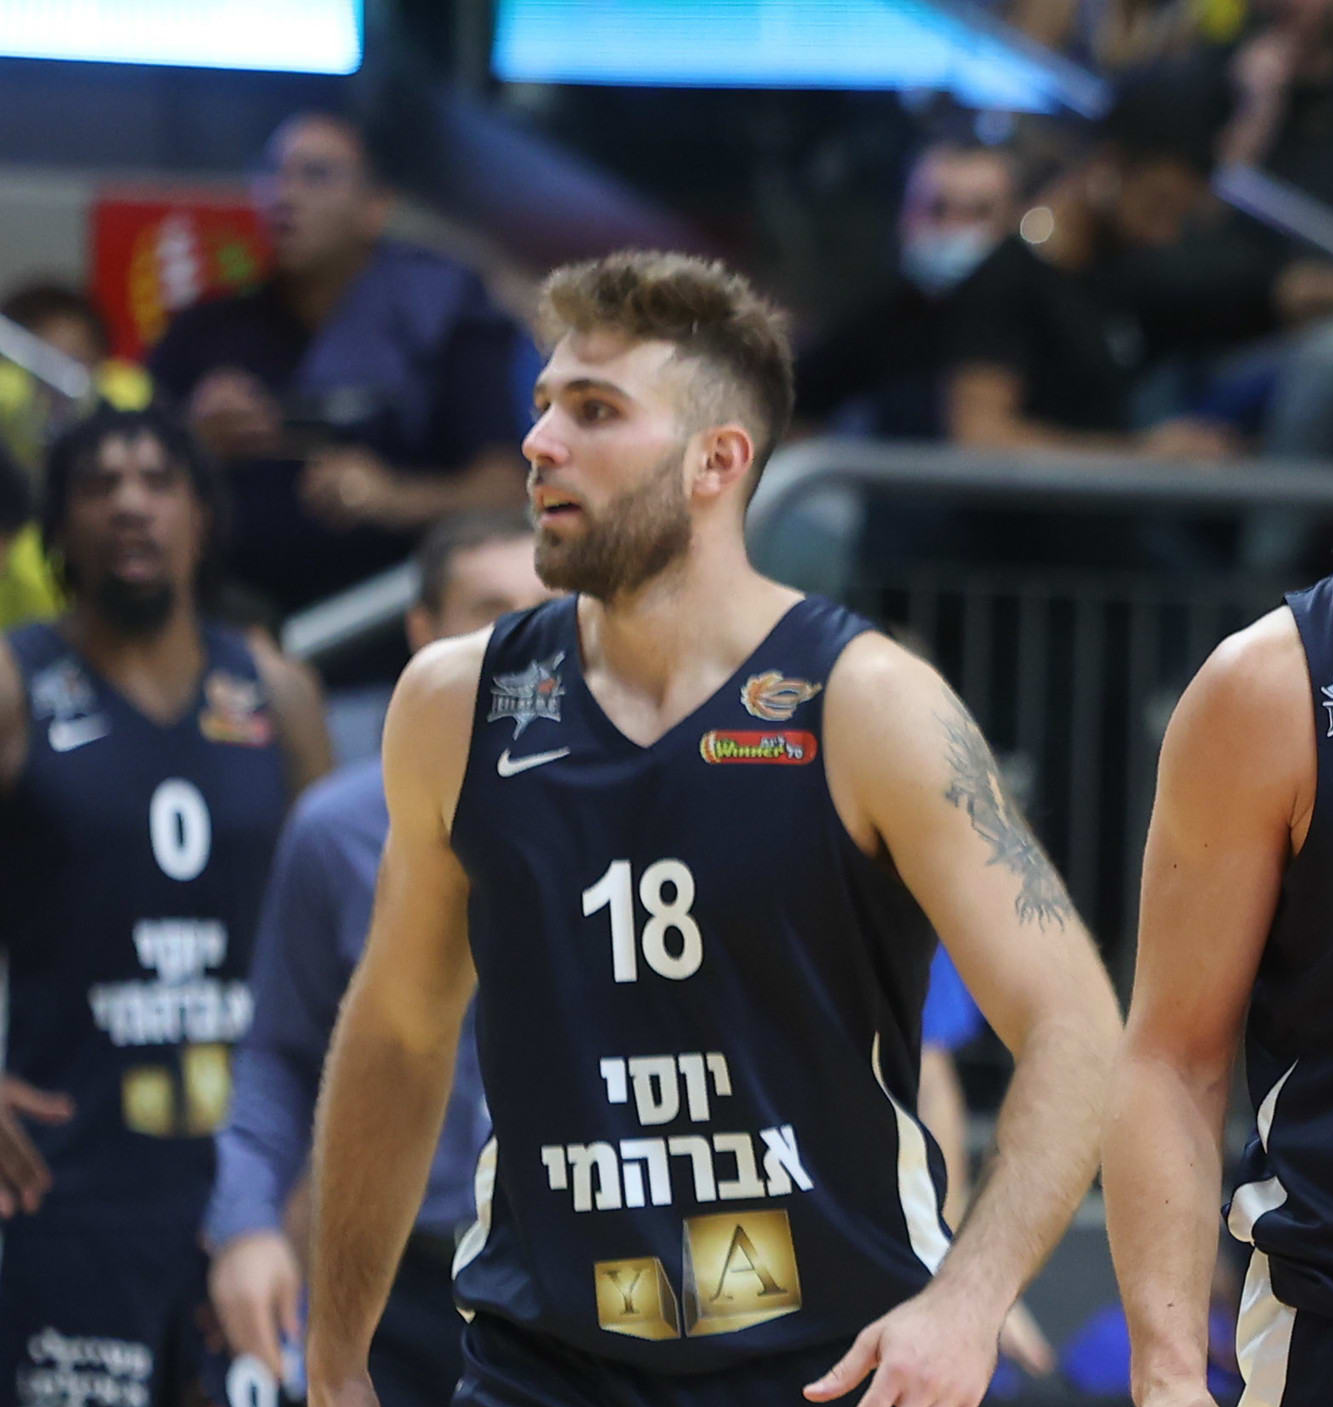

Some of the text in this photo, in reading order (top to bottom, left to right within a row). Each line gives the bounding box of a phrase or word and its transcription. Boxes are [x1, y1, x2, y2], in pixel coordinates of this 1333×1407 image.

[716, 740, 784, 757] Winner
[150, 777, 211, 881] 0
[582, 858, 703, 983] 18
[600, 1053, 732, 1126] יוסי
[541, 1125, 814, 1212] אברהמי
[603, 1223, 787, 1315] Y A
